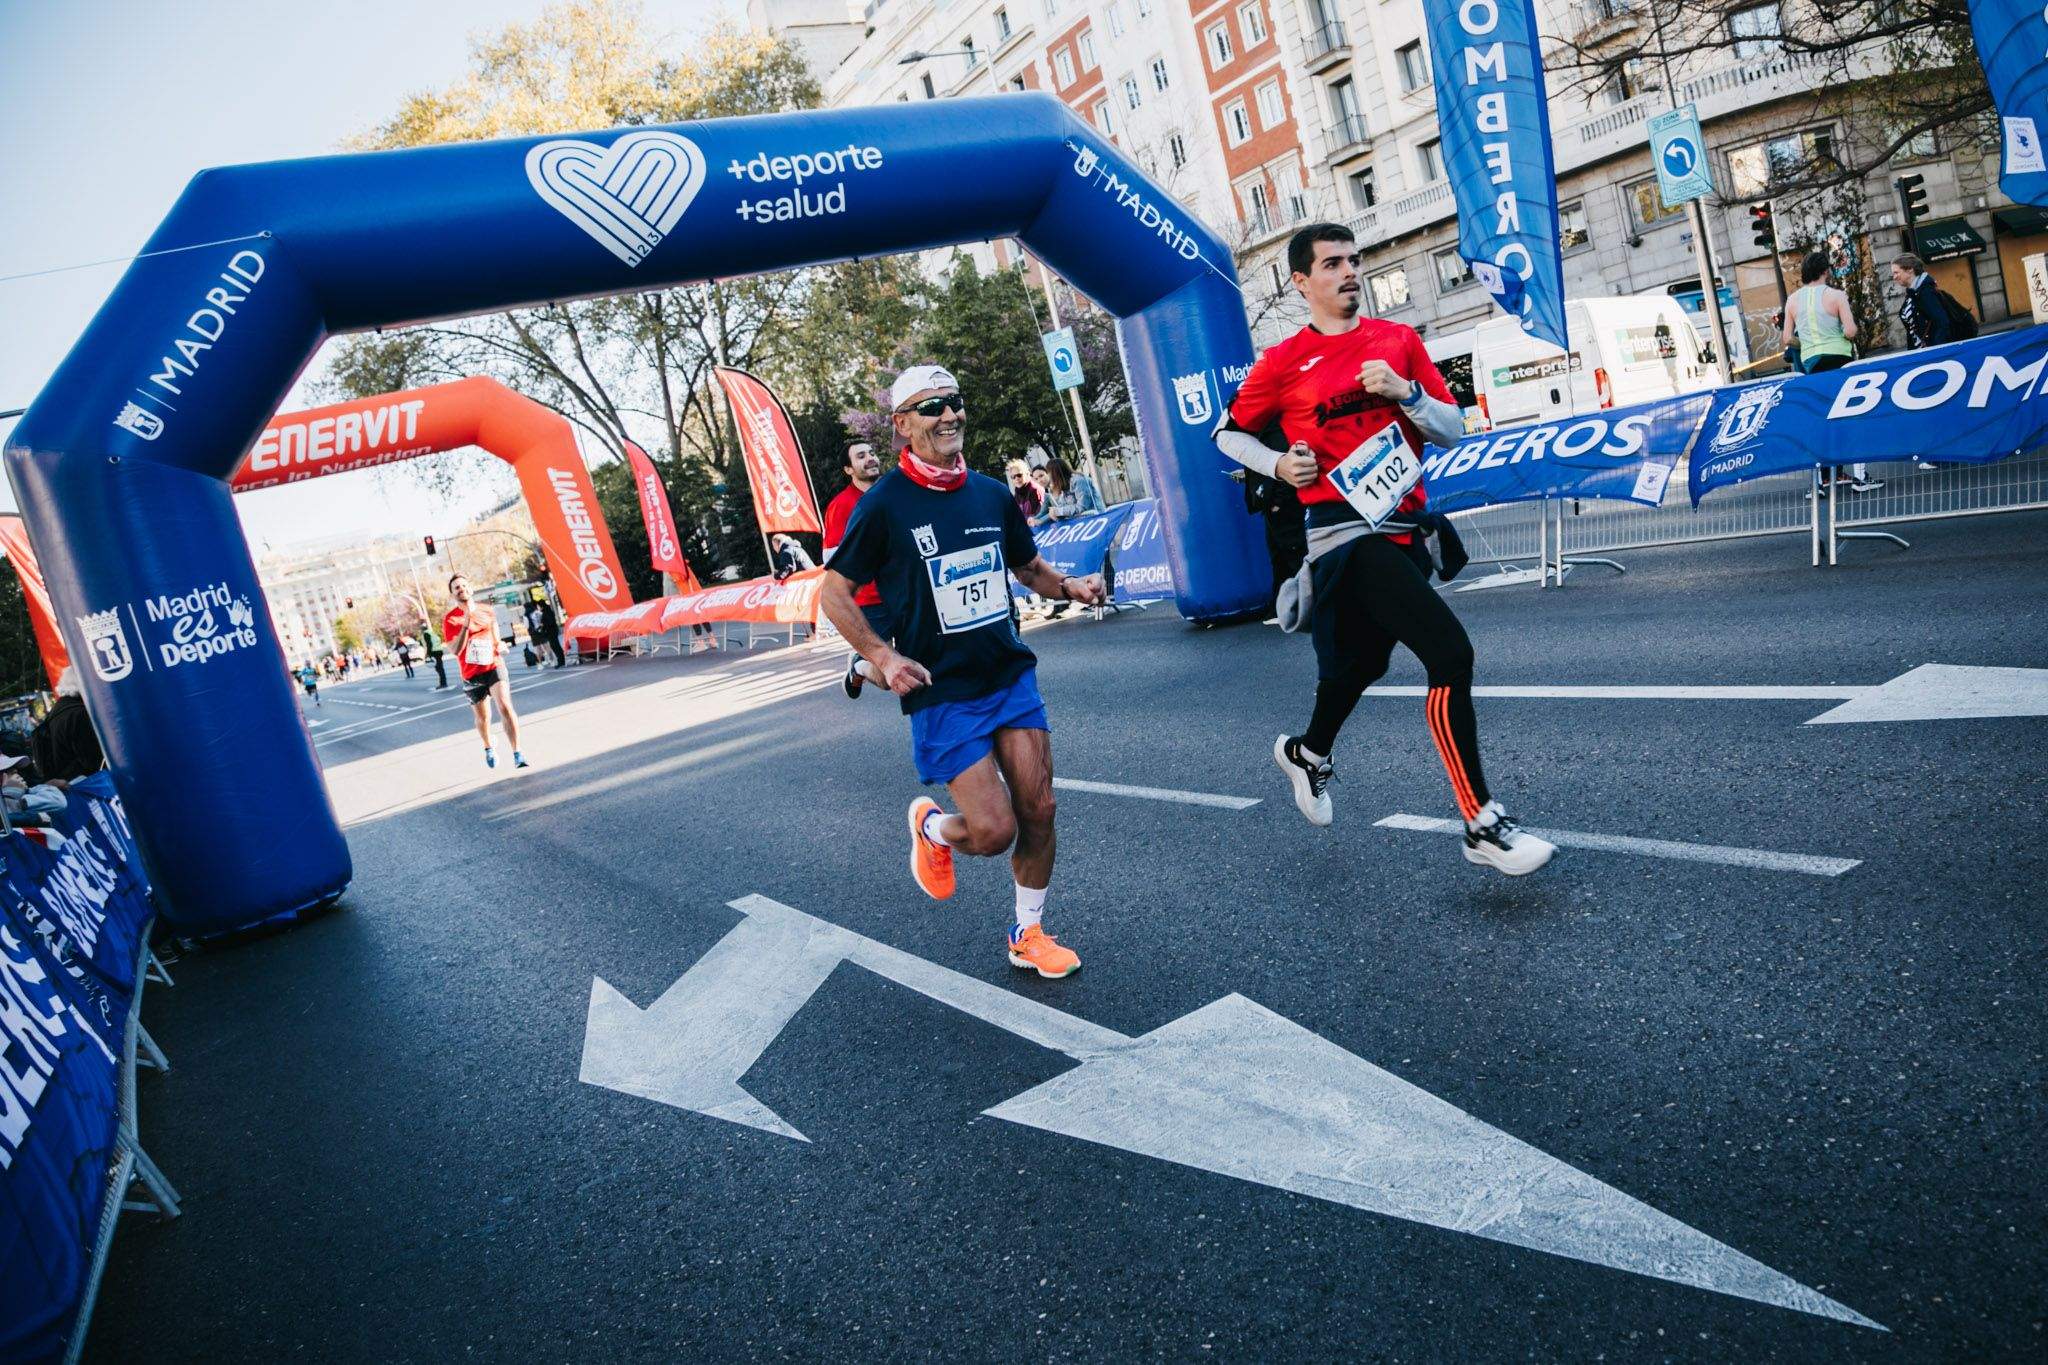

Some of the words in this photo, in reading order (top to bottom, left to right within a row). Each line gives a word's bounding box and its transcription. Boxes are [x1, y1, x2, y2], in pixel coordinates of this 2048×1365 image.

[727, 144, 883, 185] +deporte
[735, 182, 846, 224] +salud
[1104, 173, 1199, 260] MADRID
[150, 250, 266, 396] MADRID
[1495, 355, 1581, 384] enterprise
[251, 400, 425, 472] ENERVIT
[1364, 456, 1409, 500] 1102
[1711, 453, 1754, 475] MADRID
[546, 467, 604, 559] ENERVIT
[145, 581, 232, 622] Madrid
[957, 579, 988, 606] 757
[159, 626, 257, 668] Deporte
[172, 609, 219, 644] es
